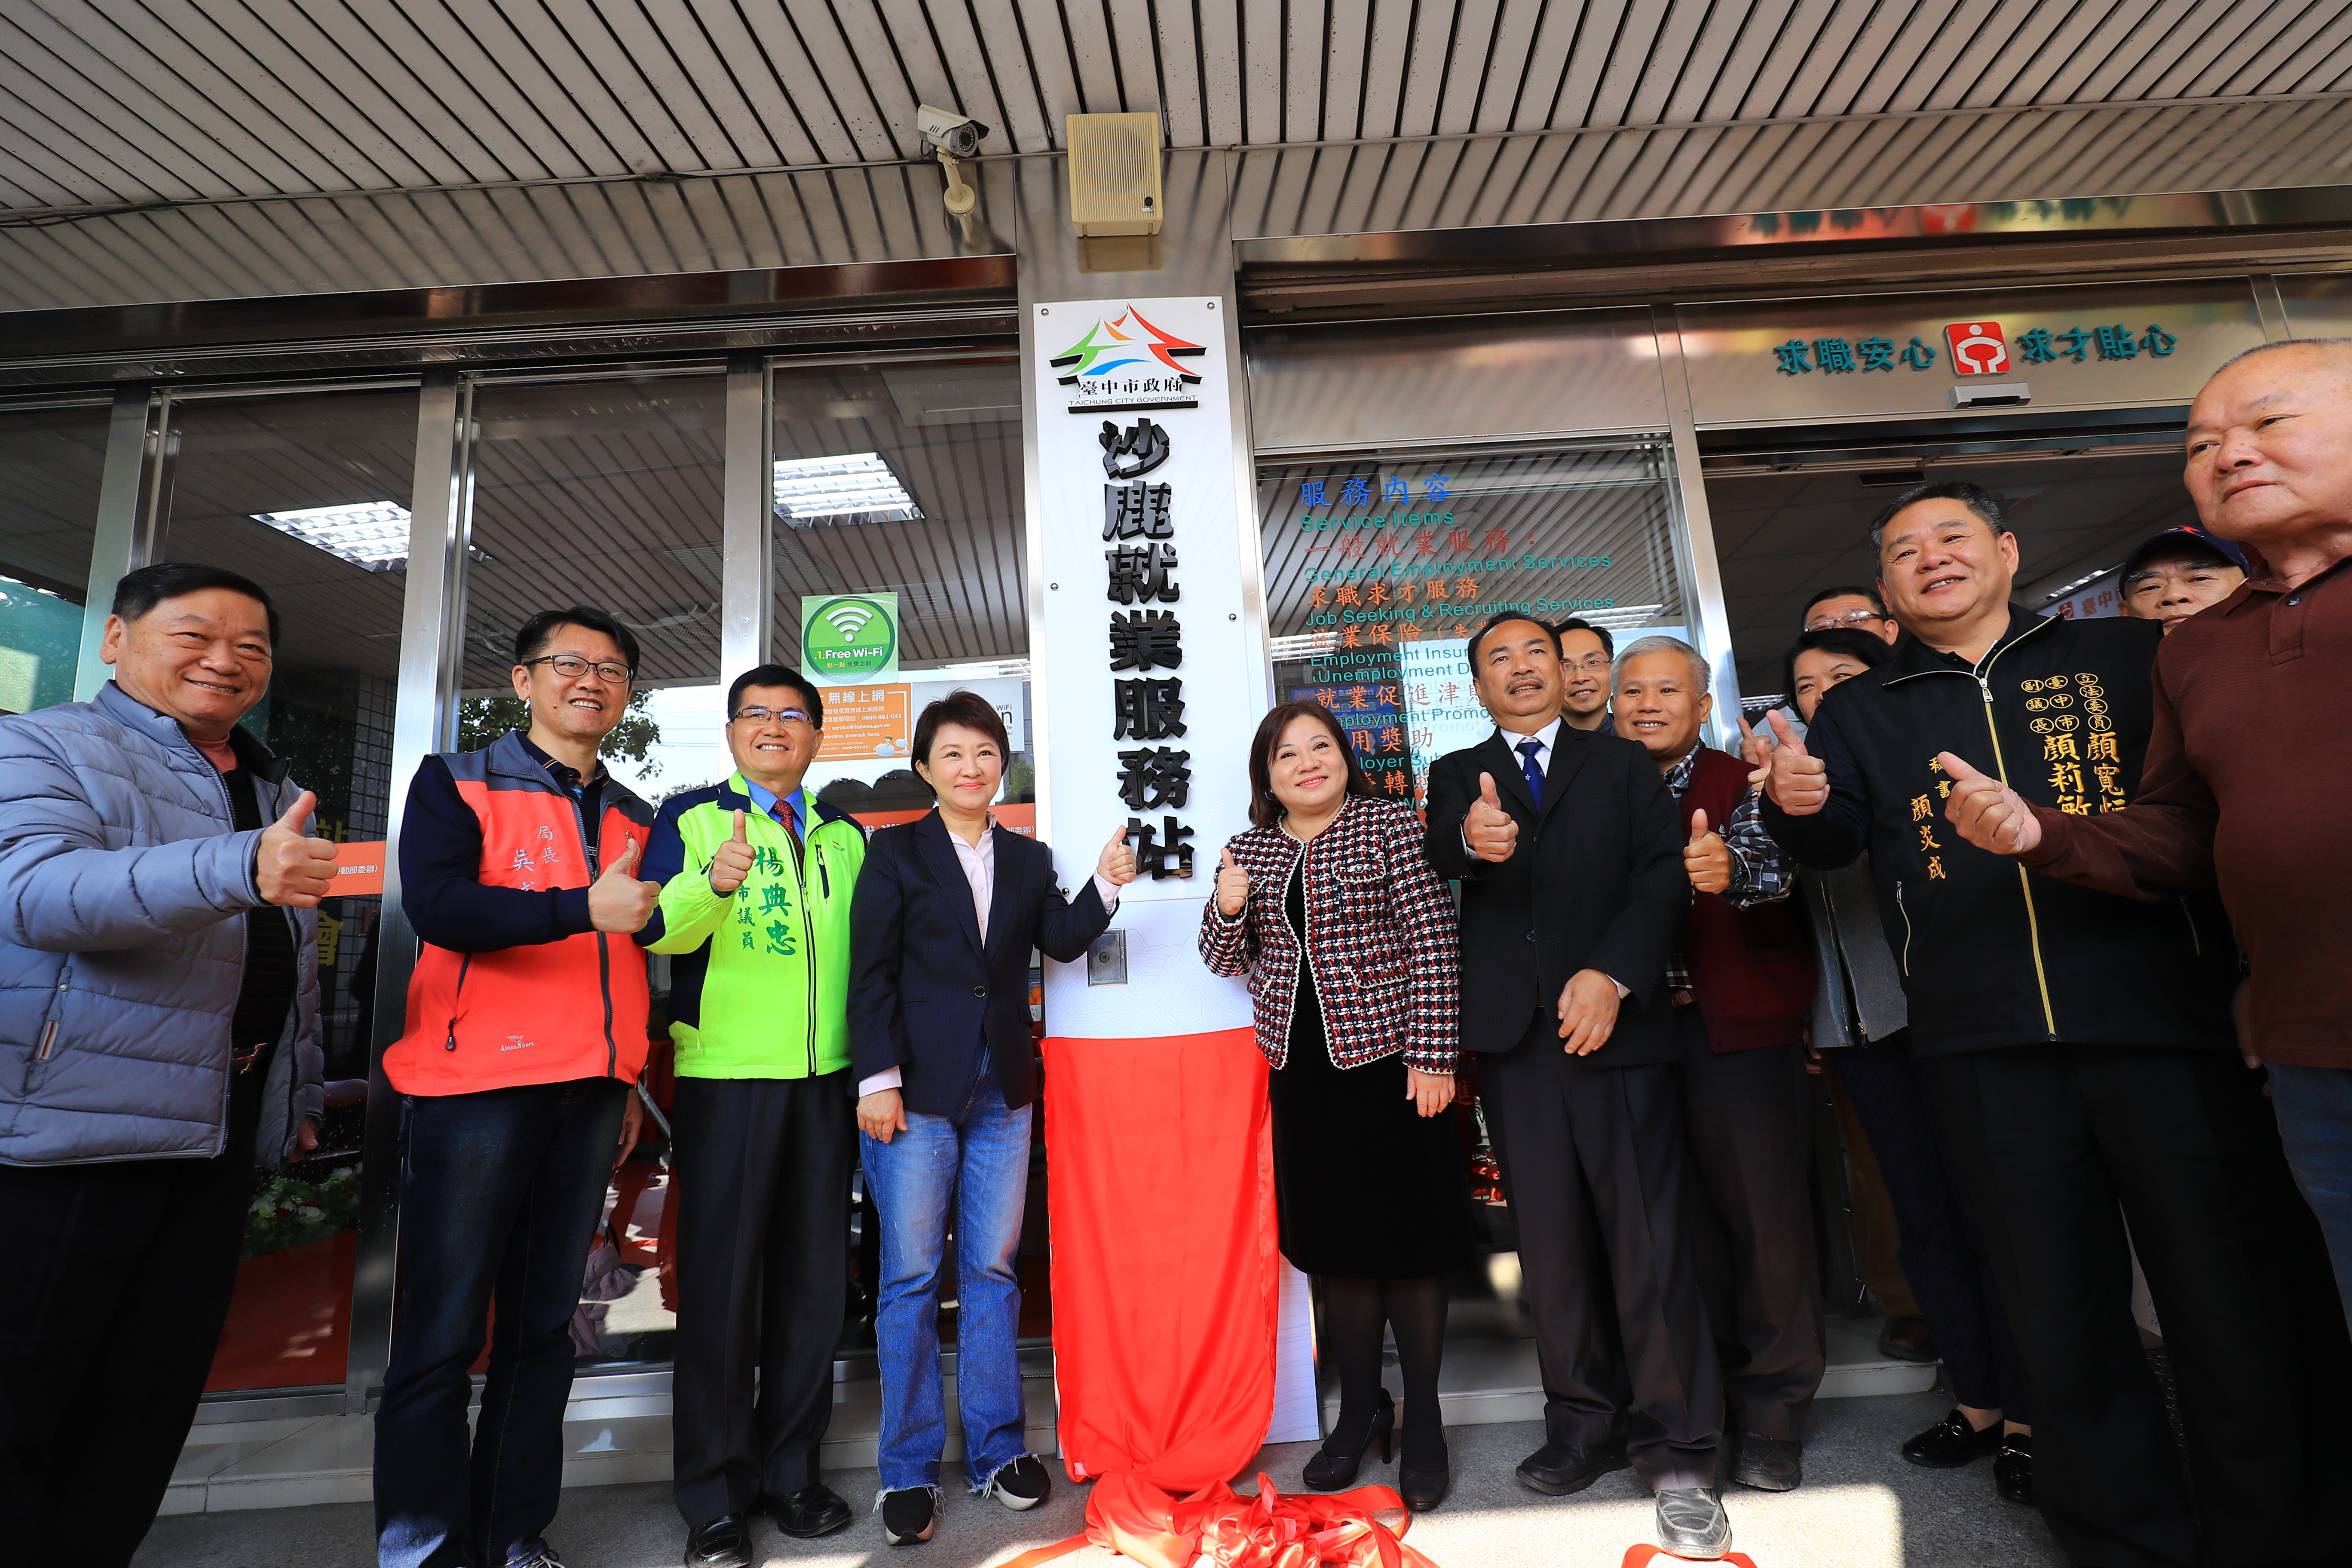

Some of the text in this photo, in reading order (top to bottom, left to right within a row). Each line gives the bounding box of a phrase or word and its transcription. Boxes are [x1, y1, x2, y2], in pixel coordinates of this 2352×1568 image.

[1774, 337, 1936, 375] 求職安心
[2018, 324, 2177, 363] 求才貼心
[1080, 377, 1182, 396] 臺中市政府
[1136, 395, 1197, 403] GOVERNMENT
[1300, 511, 1455, 532] Service Items
[1305, 554, 1611, 582] General Employment Services
[1308, 576, 1480, 609] 求職求才服務
[1306, 597, 1615, 626] Job Seeking & Recruiting Services
[852, 646, 883, 658] Wi-Fi
[1099, 418, 1195, 881] 沙鹿就業服務站
[1311, 649, 1419, 668] Employment
[819, 689, 885, 704] 無線上網
[2077, 674, 2108, 730] 立法委員
[1335, 710, 1426, 729] mployment
[537, 826, 560, 864] 局長
[1911, 794, 1946, 880] 顏炎成
[754, 845, 796, 956] 楊典忠
